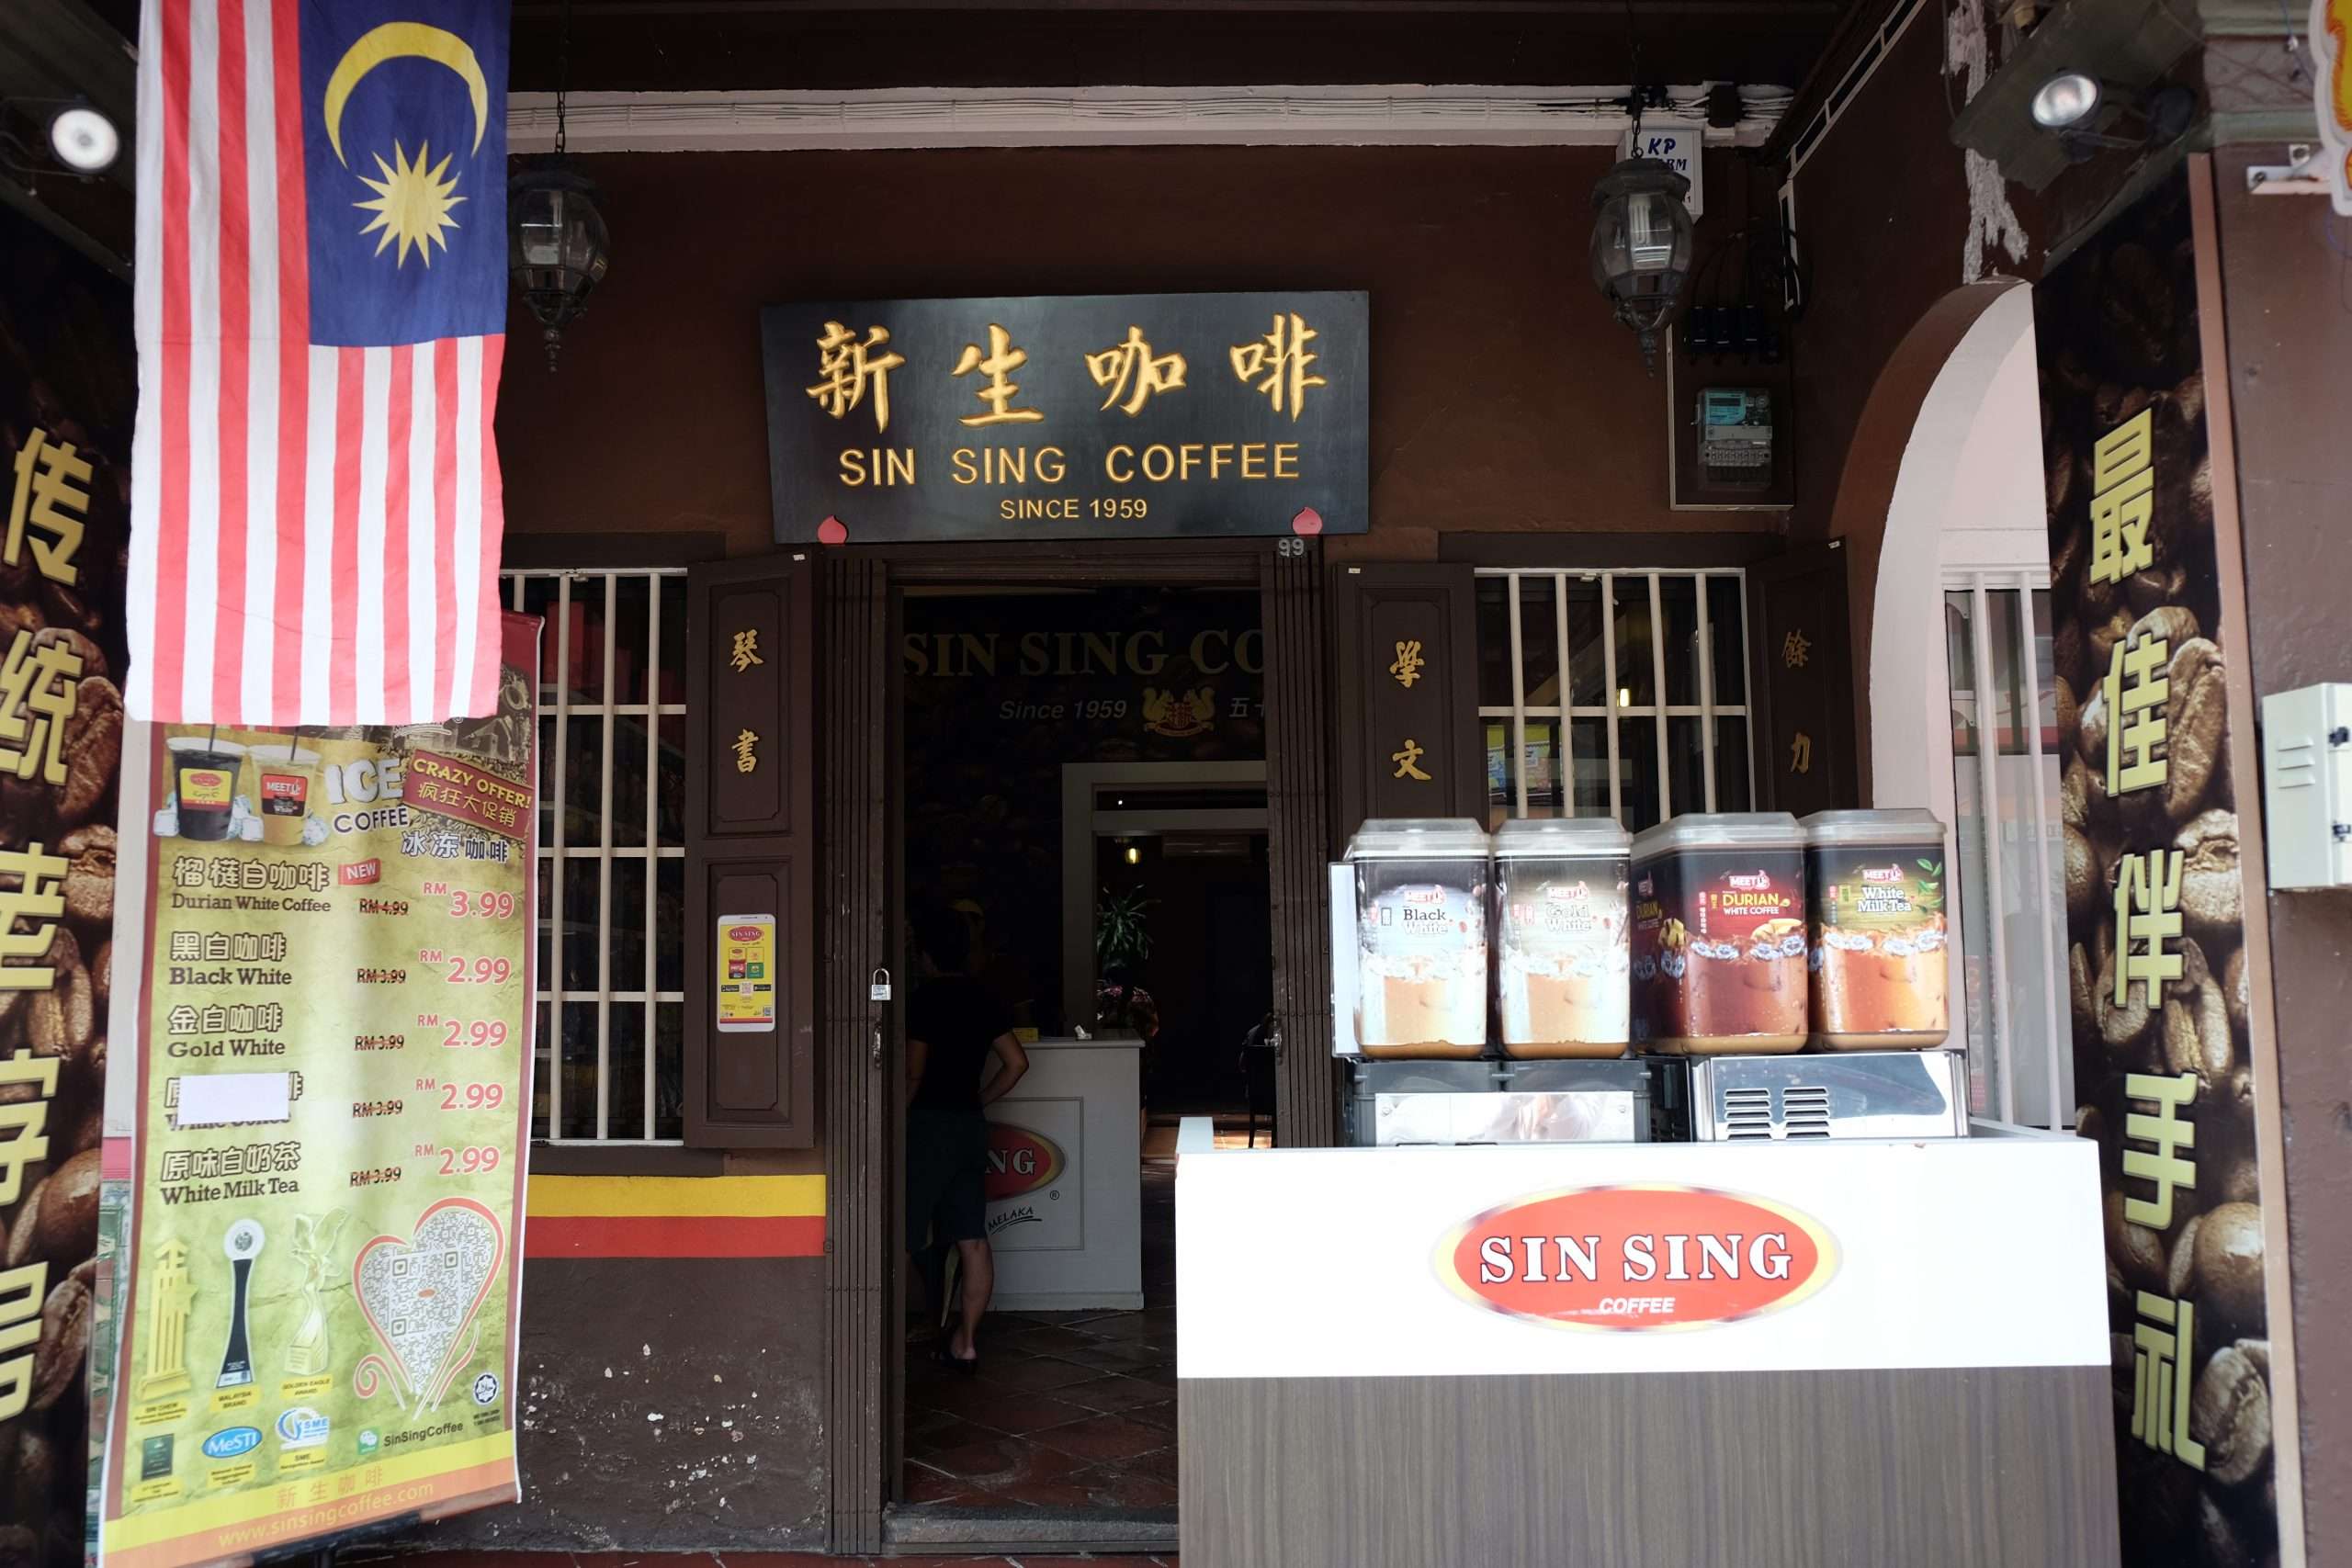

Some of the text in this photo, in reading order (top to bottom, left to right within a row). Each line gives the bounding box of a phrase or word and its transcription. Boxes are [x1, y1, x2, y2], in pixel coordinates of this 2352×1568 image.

[1648, 138, 1677, 155] KP
[806, 311, 1327, 434] 新生咖啡
[839, 442, 1300, 486] SIN SING COFFEE
[1000, 498, 1148, 520] SINCE 1959
[1278, 538, 1305, 557] 99
[904, 631, 999, 677] SIN
[1020, 630, 1169, 676] SING
[1000, 698, 1127, 720] Since 1959
[325, 758, 404, 805] ICE
[413, 758, 533, 809] CRAZY OFFER!
[418, 780, 516, 828] 疯狂大促销
[334, 807, 410, 834] COFFEE
[401, 829, 509, 863] 冰冻咖啡
[346, 862, 377, 880] NEW
[172, 893, 332, 912] Durian White Coffee
[424, 882, 514, 919] RM 3.99
[1722, 893, 1780, 906] DURIAN
[1857, 899, 1912, 912] Milk Tea
[1861, 886, 1905, 900] White
[1404, 908, 1447, 920] Black
[1724, 906, 1780, 916] WHITE COFFEE
[171, 931, 287, 962] 黑白咖啡
[2089, 407, 2205, 1472] 最佳伴手礼
[169, 967, 293, 986] Black White
[419, 950, 511, 985] RM 2.99
[168, 1002, 283, 1034] 金白咖啡
[417, 1014, 508, 1048] RM 2.99
[167, 1038, 286, 1057] Gold White
[415, 1078, 503, 1111] RM 2.99
[161, 1141, 301, 1182] 原味白奶茶
[414, 1144, 501, 1175] RM 2.99
[985, 1148, 1036, 1175] NG
[160, 1179, 300, 1206] White Milk Tea
[987, 1206, 1035, 1231] MELAKA
[1479, 1231, 1793, 1284] SIN SING
[1599, 1296, 1676, 1314] COFFEE
[207, 1432, 257, 1455] MeSTI
[383, 1421, 463, 1448] SinSingCoffee
[278, 1467, 383, 1509] 新生咖啡
[218, 1481, 434, 1549] www.sinsingcoffee.com
